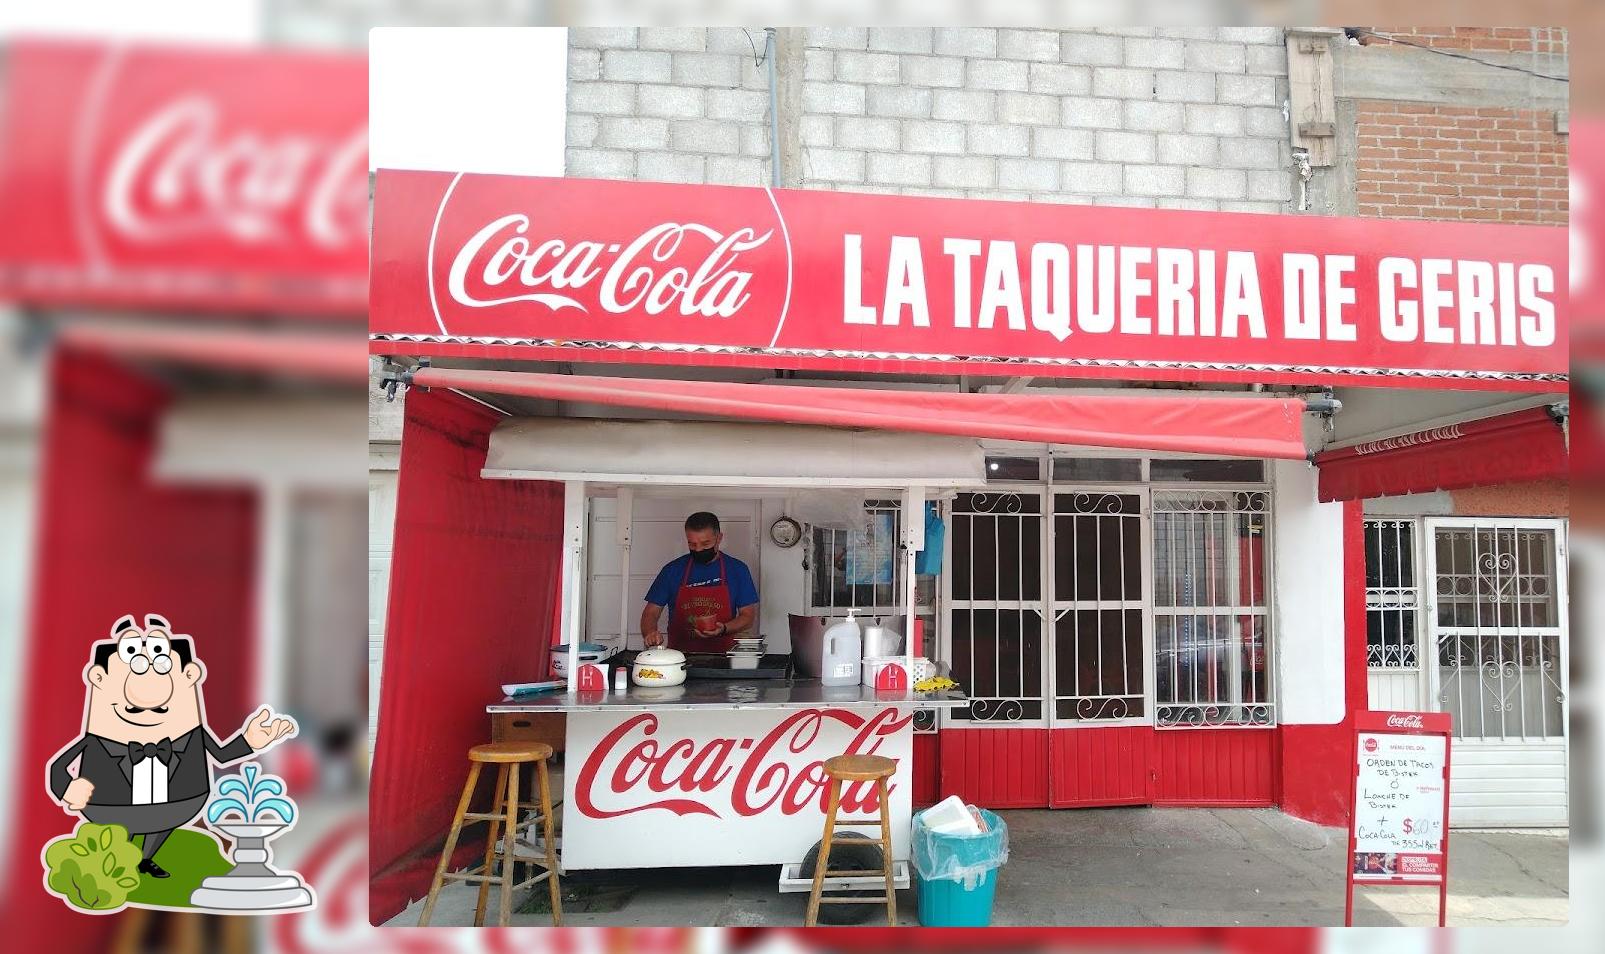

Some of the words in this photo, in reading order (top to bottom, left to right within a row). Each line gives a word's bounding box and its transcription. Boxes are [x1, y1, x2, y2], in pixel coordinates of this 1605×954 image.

[449, 213, 774, 318] Coca-Cola
[844, 234, 931, 327] LA
[943, 238, 1267, 342] TAQUERIA
[1282, 252, 1357, 341] DE
[1378, 256, 1555, 347] GERIS
[1366, 758, 1396, 768] ORDEN
[1397, 759, 1408, 767] DE
[1409, 759, 1435, 769] TACOS
[1376, 769, 1389, 777] DE
[1363, 787, 1396, 799] LONCHE
